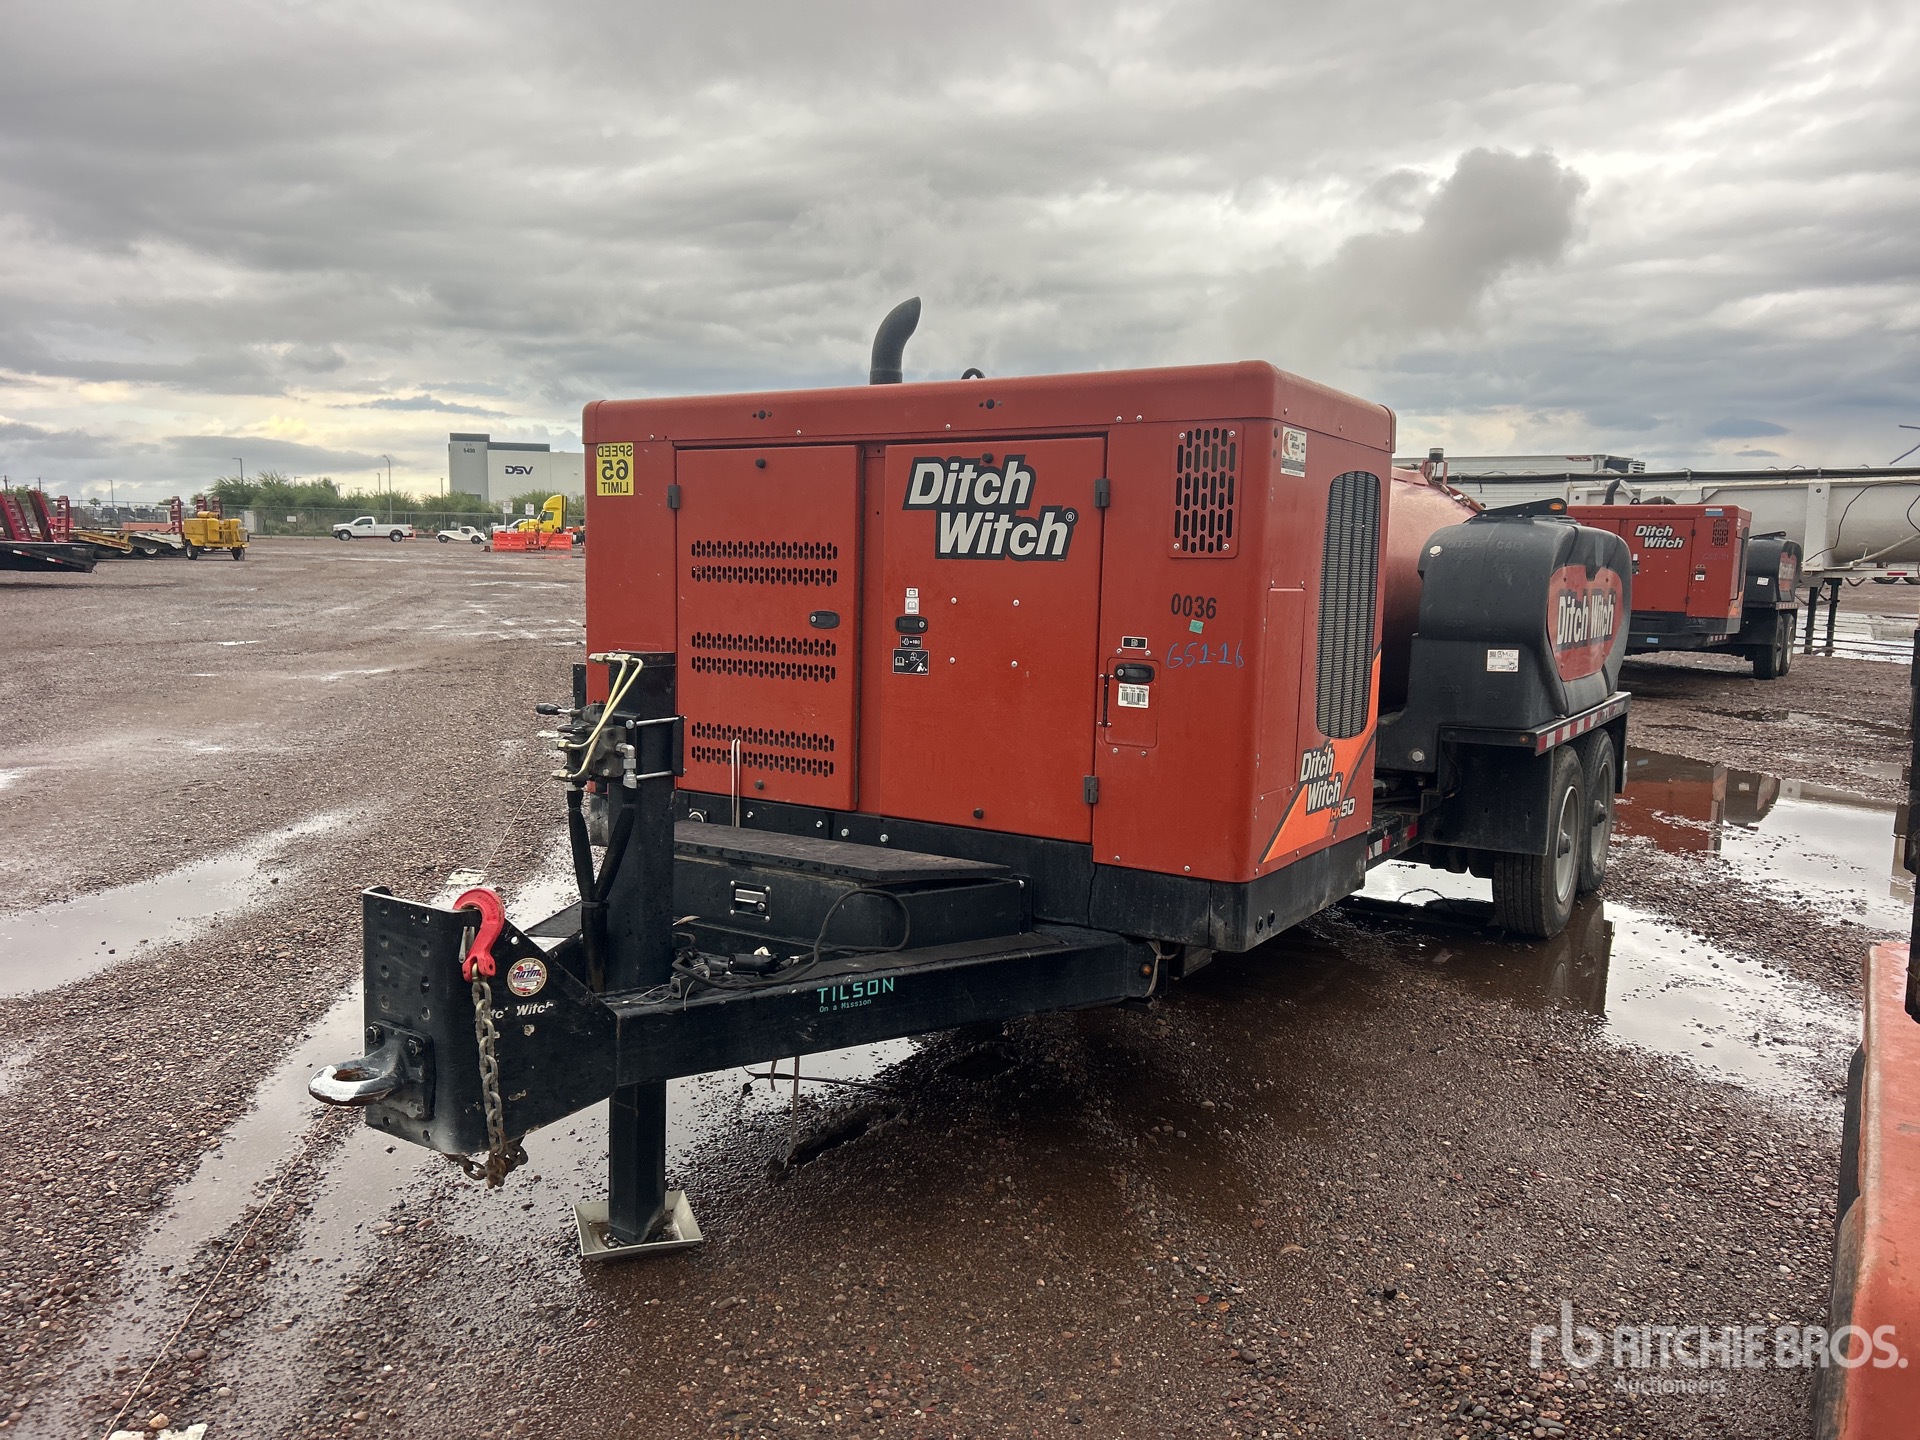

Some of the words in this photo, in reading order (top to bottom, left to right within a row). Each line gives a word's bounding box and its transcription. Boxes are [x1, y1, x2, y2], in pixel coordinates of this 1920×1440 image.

[505, 465, 533, 475] DSV
[908, 460, 1031, 505] Ditch
[1634, 525, 1673, 538] Ditch
[1643, 537, 1684, 549] Witch
[1171, 593, 1217, 619] 0036
[1556, 595, 1589, 645] Ditch
[1590, 594, 1614, 639] Witch
[1300, 747, 1335, 782] Ditch
[1307, 775, 1342, 812] Witch
[817, 976, 894, 1004] TILSON
[819, 1005, 829, 1013] On
[841, 999, 872, 1010] Mission
